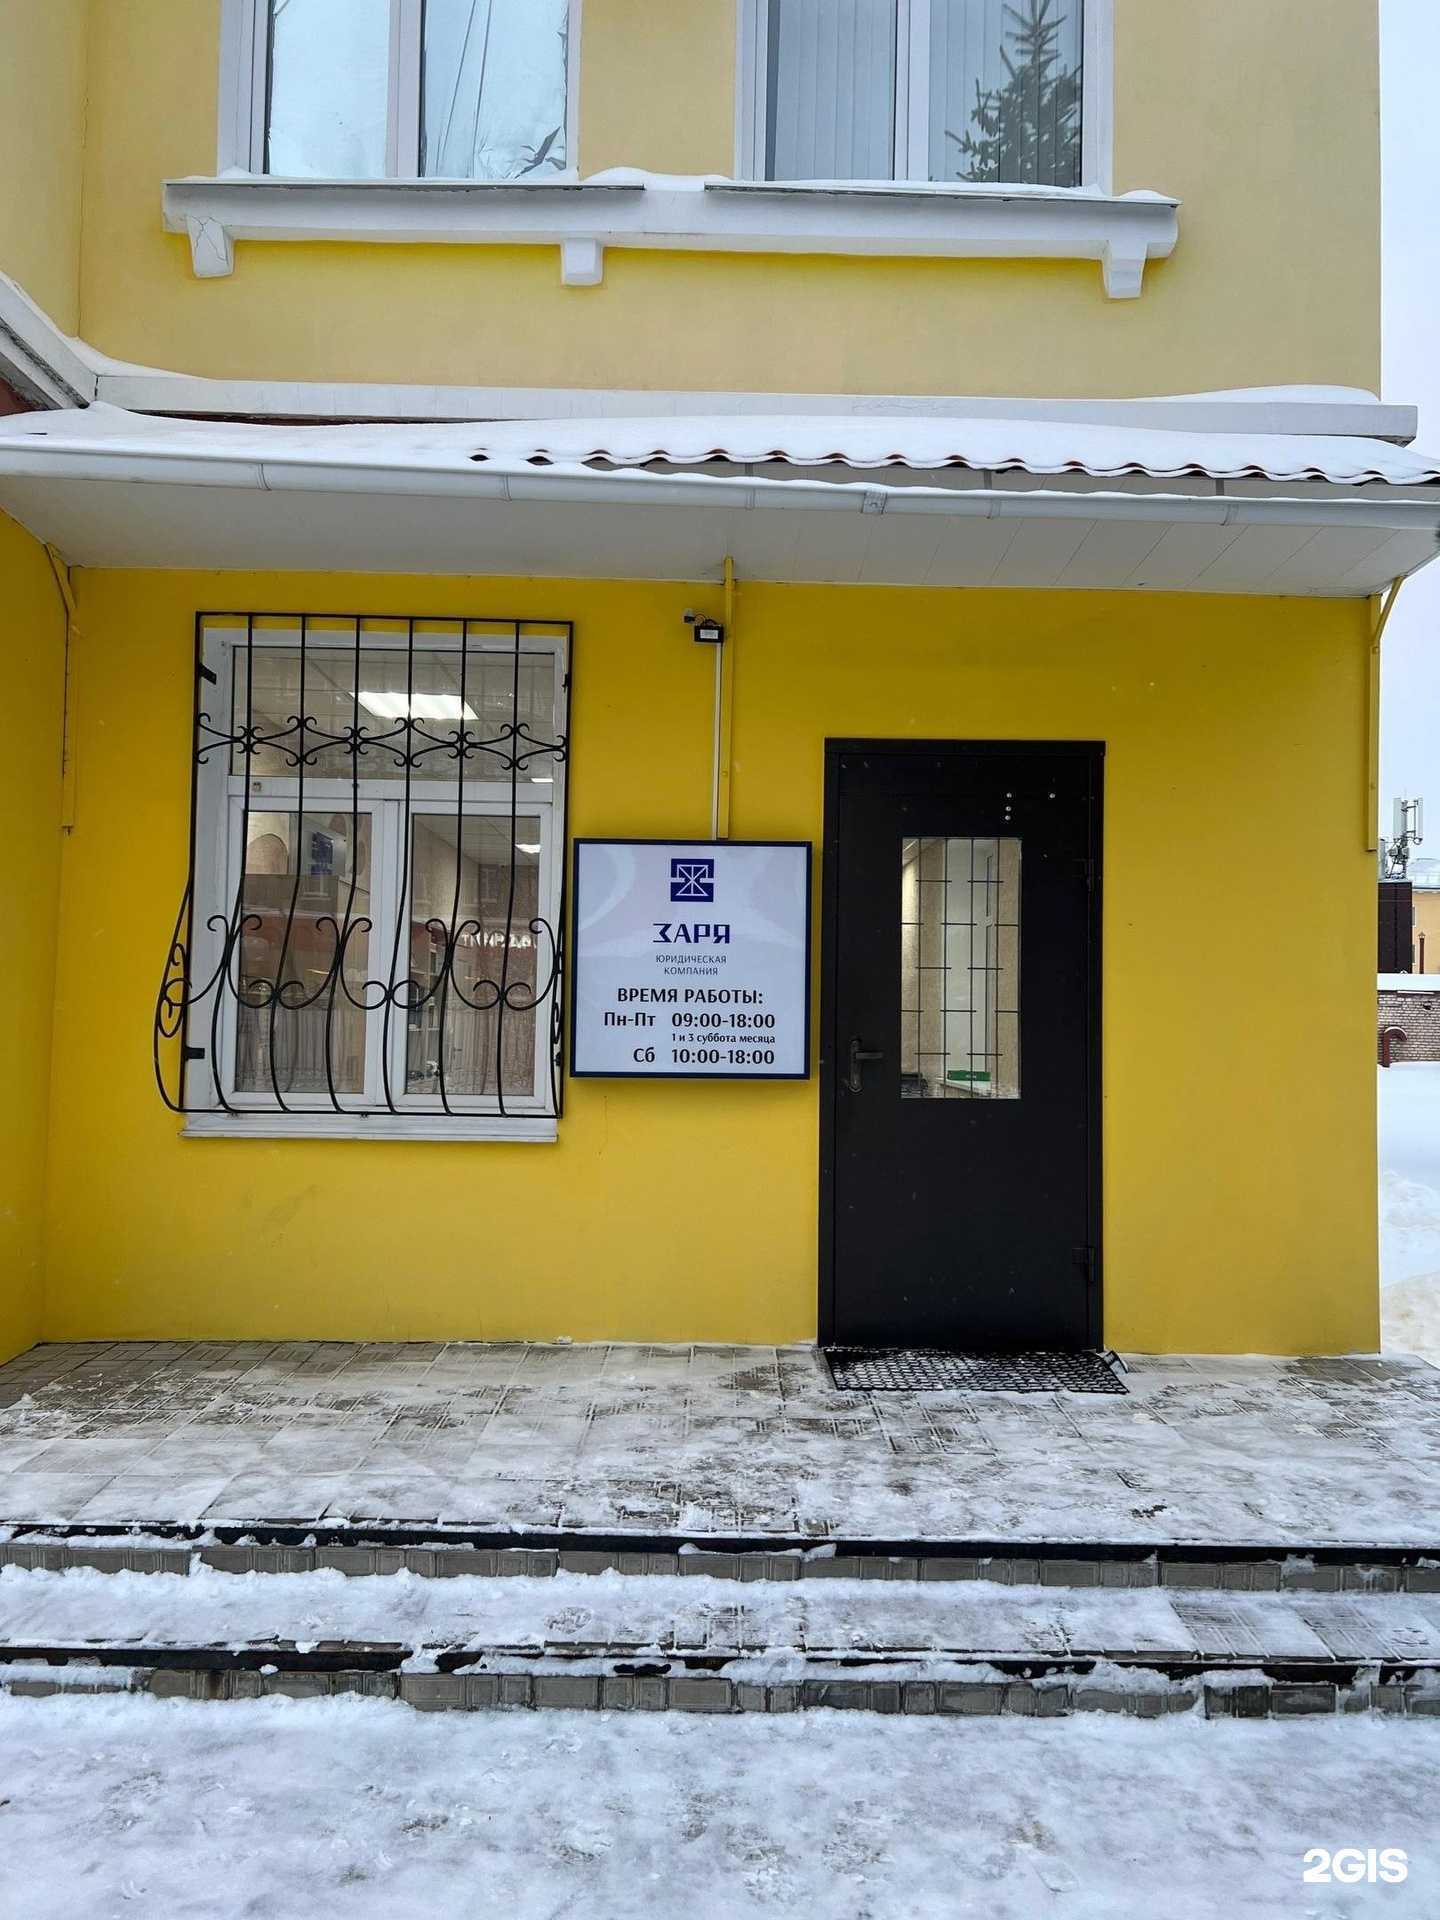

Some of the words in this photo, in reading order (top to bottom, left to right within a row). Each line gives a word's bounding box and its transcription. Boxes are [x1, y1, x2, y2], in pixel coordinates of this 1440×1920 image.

[652, 923, 731, 944] ЗАРЯ
[655, 954, 727, 964] ЮРИДИЧЕСКАЯ
[664, 966, 718, 976] КОМПАНИЯ
[617, 987, 678, 1003] ВРЕМЯ
[684, 989, 763, 1005] РАБОТЫ:
[604, 1011, 657, 1027] Пн-Пт
[671, 1012, 776, 1029] 09:00-18:00
[671, 1033, 677, 1042] 1
[678, 1034, 686, 1042] и
[688, 1033, 695, 1043] 3
[696, 1033, 737, 1045] суббота
[739, 1034, 776, 1044] месяца
[633, 1046, 656, 1063] Сб
[671, 1048, 775, 1065] 10:00-18:00
